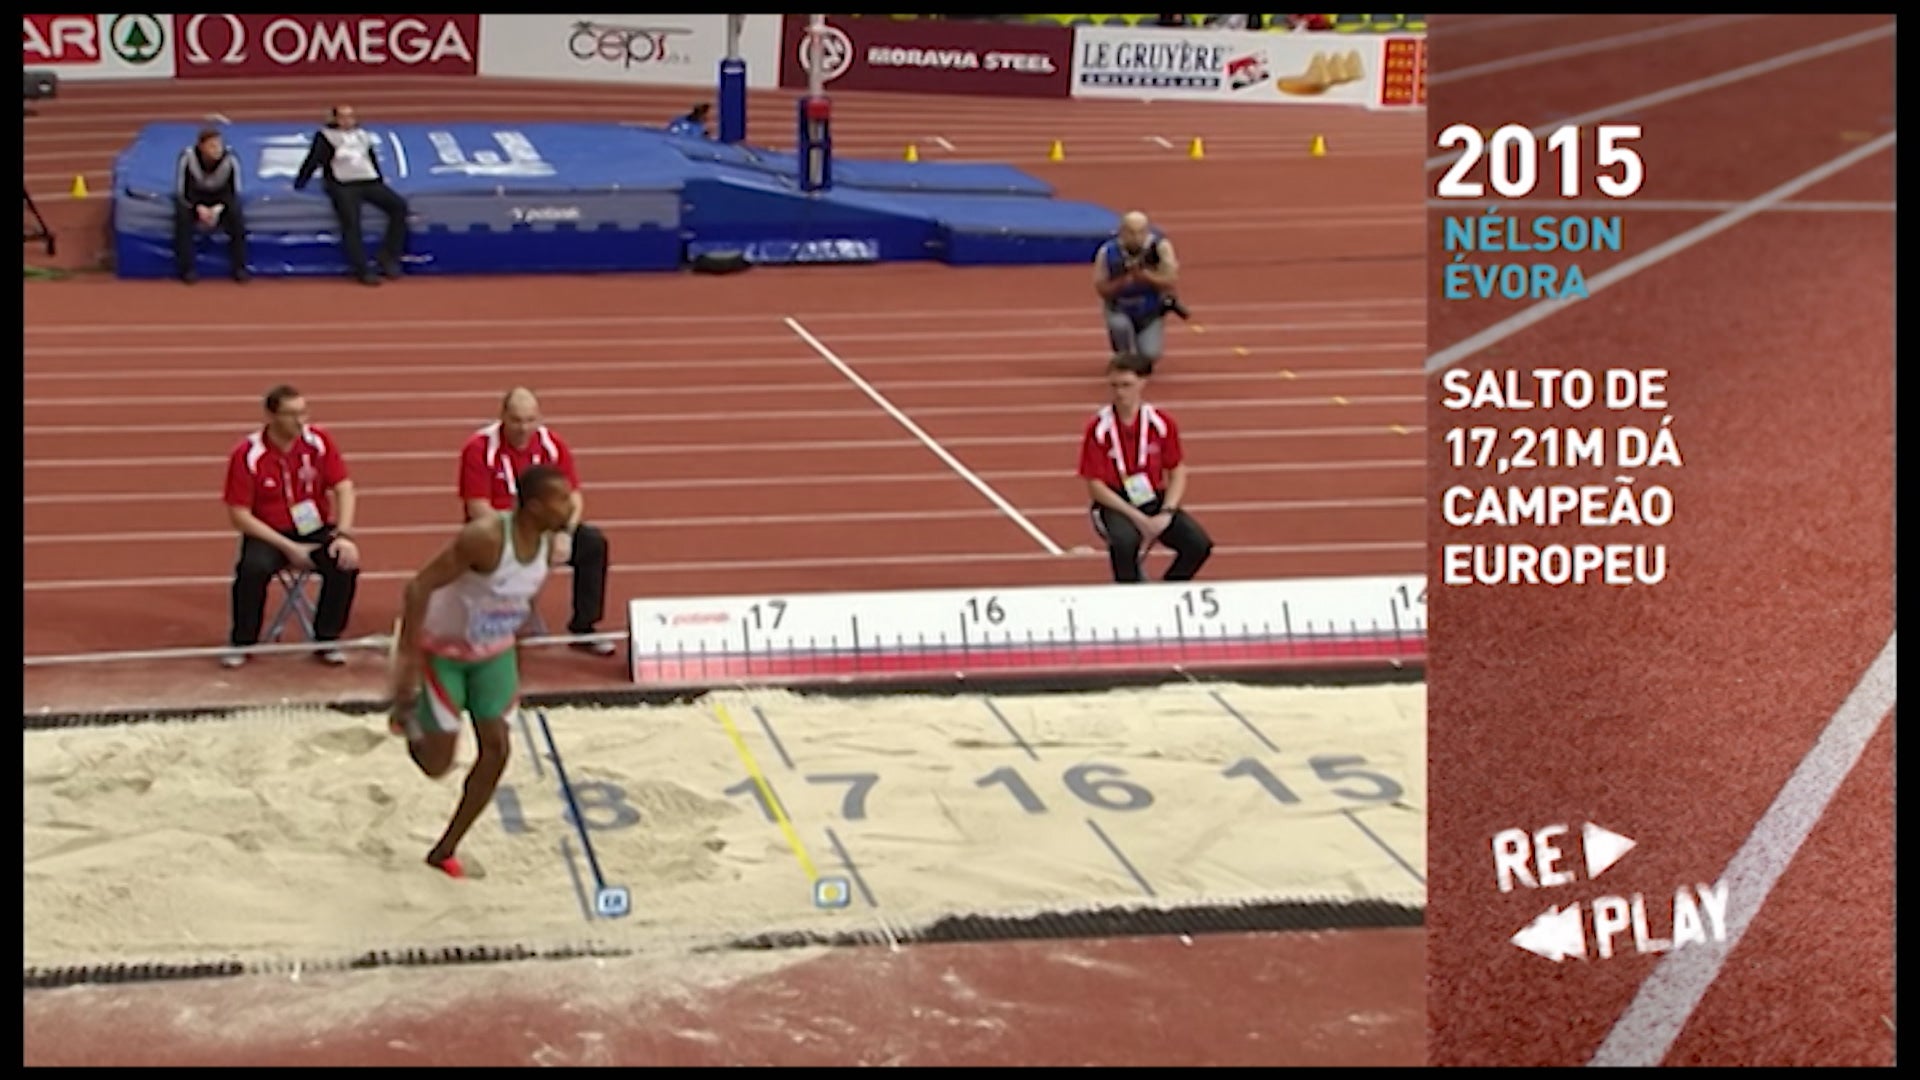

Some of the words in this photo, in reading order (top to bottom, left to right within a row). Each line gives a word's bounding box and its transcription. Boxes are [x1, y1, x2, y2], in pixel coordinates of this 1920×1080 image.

[262, 19, 473, 64] OMEGA
[1082, 42, 1111, 68] LE
[1116, 39, 1225, 73] GRUYÈRE
[867, 46, 979, 69] MORAVIA
[983, 51, 1056, 73] STEEL
[750, 600, 788, 629] 17
[966, 597, 1006, 625] 16
[1181, 588, 1221, 618] 15
